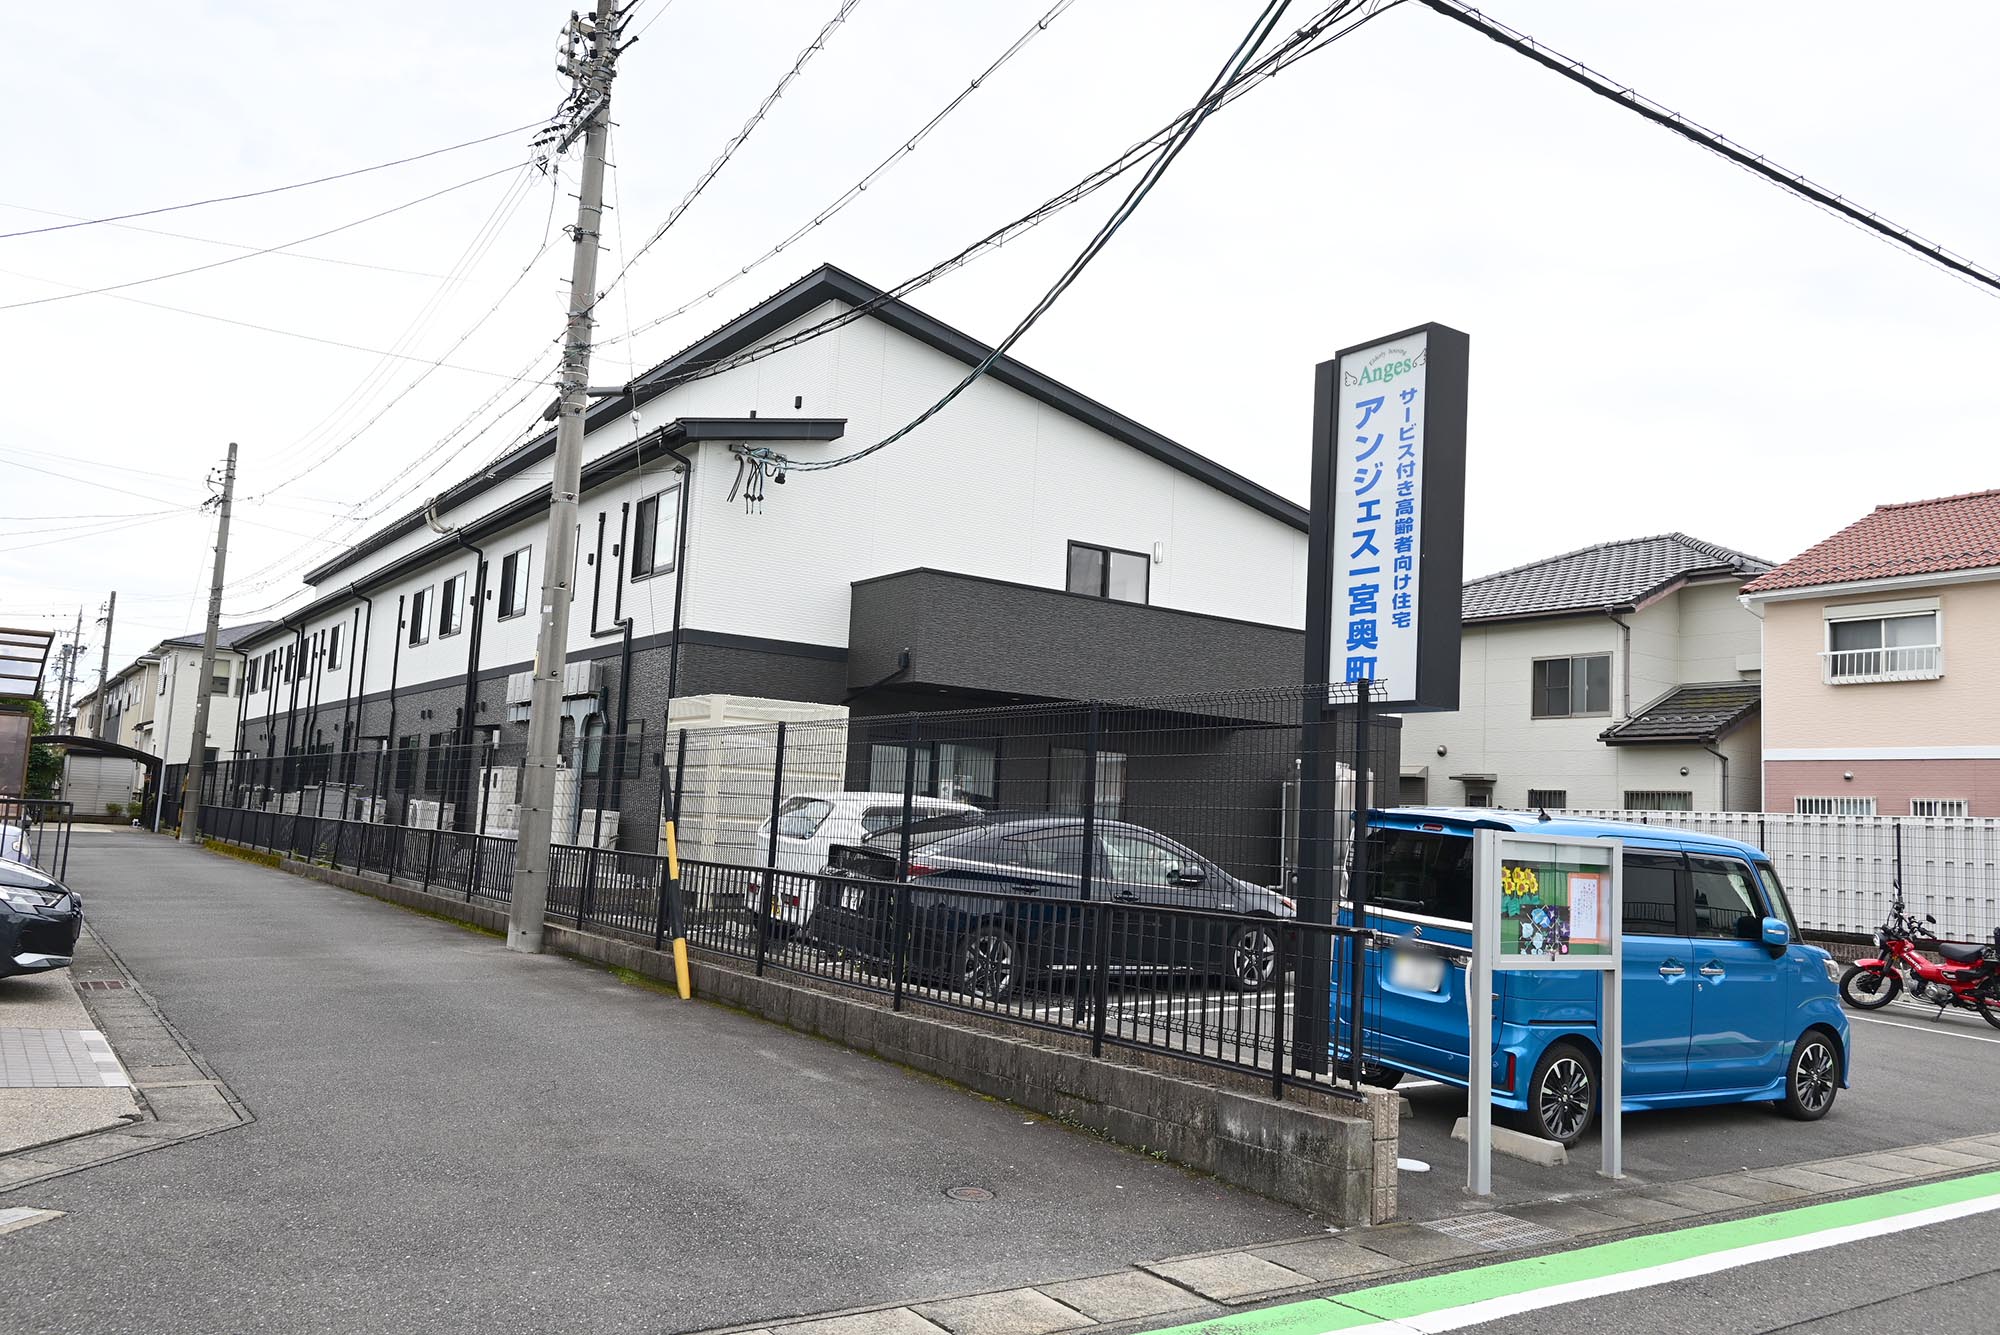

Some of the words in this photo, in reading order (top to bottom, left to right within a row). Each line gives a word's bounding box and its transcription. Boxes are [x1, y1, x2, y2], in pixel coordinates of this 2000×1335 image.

[1358, 358, 1412, 386] Anges
[1345, 396, 1385, 685] アンジェス一宮奥町
[1391, 387, 1418, 629] サービス付き高齢者向け住宅
